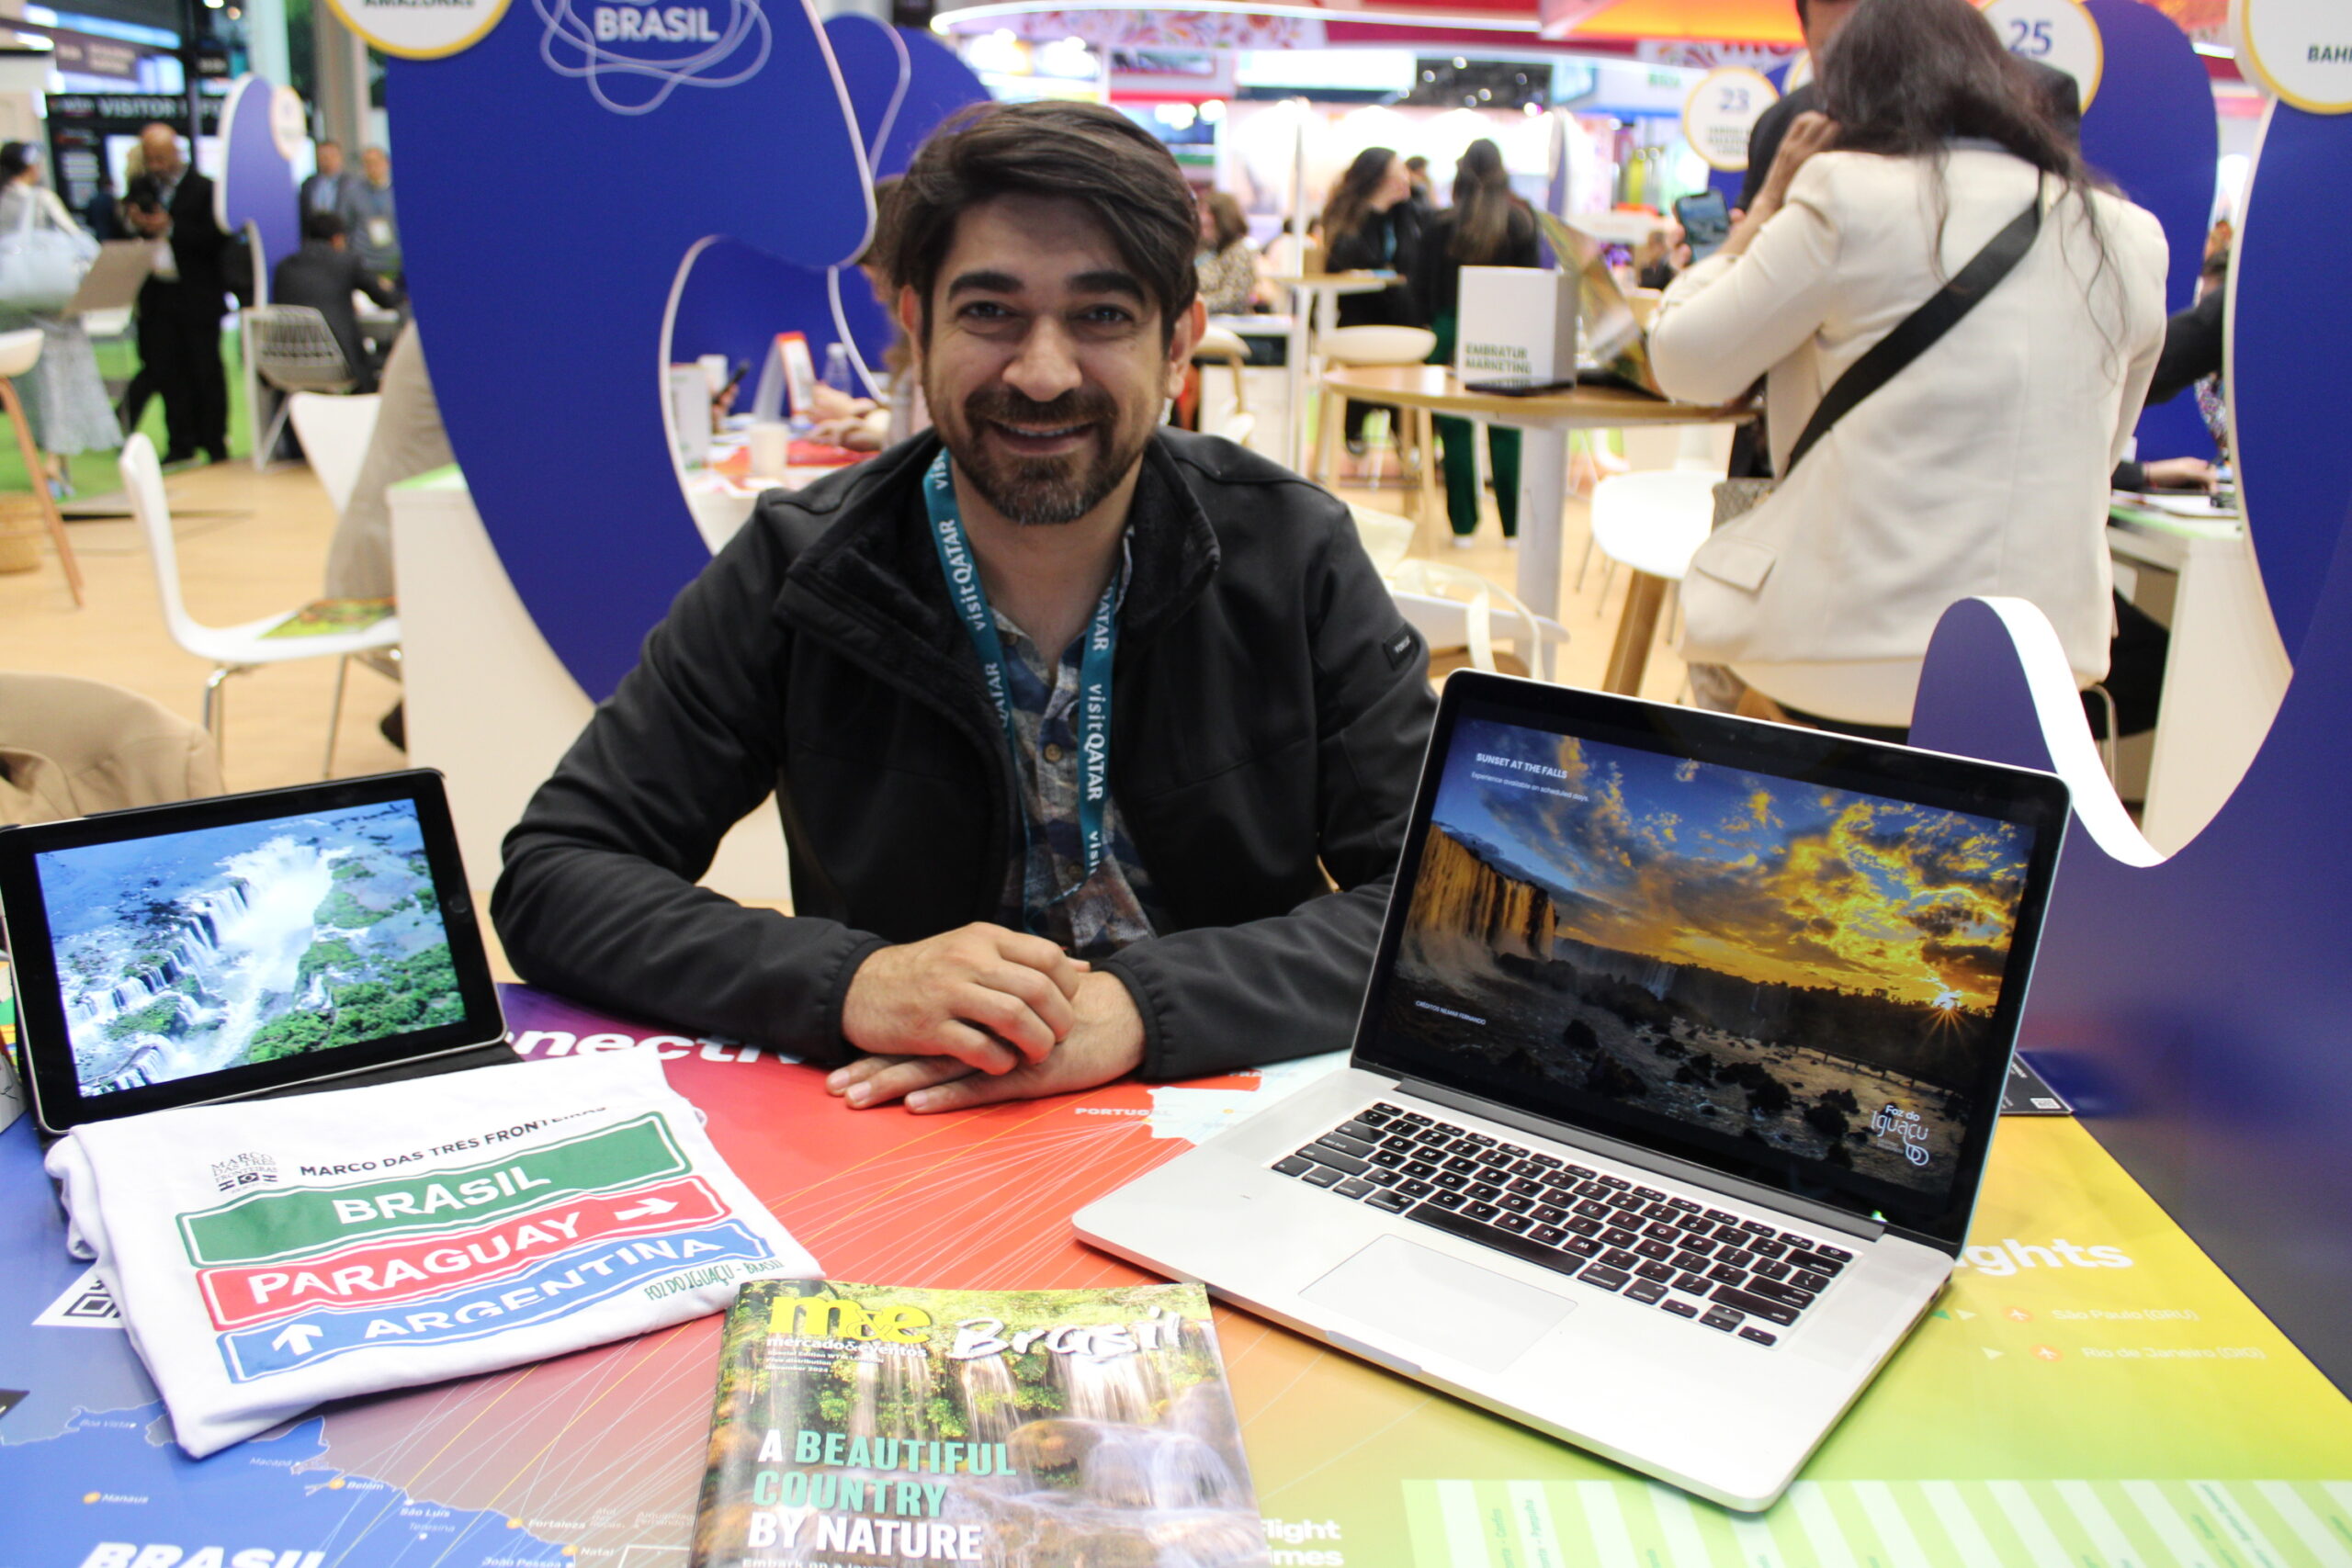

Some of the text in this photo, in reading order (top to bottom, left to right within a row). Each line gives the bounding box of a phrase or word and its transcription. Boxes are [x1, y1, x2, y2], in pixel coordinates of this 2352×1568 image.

[594, 7, 720, 41] BRASIL
[2008, 18, 2052, 55] 25
[98, 96, 177, 118] VISITOR
[1720, 88, 1749, 110] 23
[1465, 343, 1528, 359] EMBRATUR
[1465, 356, 1532, 375] MARKETING
[930, 455, 949, 490] vis
[1476, 753, 1568, 780] SUNSET AT THE FALLS
[1471, 772, 1503, 784] Experience
[1503, 776, 1532, 790] available
[1540, 786, 1573, 799] scheduled
[1871, 1110, 1929, 1141] Iguaçu
[1885, 1104, 1921, 1122] Foz do
[300, 1161, 377, 1177] MARCO
[383, 1152, 424, 1168] DAS
[332, 1166, 552, 1224] BRASIL
[251, 1213, 581, 1305] PARAGUAY
[1955, 1238, 2134, 1276] ghts
[364, 1238, 726, 1339] ARGENTINA
[644, 1282, 668, 1301] FOZ
[665, 1276, 686, 1293] DO
[684, 1265, 735, 1289] IGUAÇU
[2089, 1309, 2143, 1320] Paulo
[768, 1296, 1182, 1363] m&e Brasil
[766, 1337, 928, 1359] mercado&eventos
[2081, 1347, 2114, 1359] Rio
[2117, 1347, 2142, 1359] de
[2142, 1347, 2216, 1359] Janeiro
[757, 1428, 1017, 1477] A BEAUTIFUL
[102, 1494, 149, 1504] Manaus
[752, 1470, 948, 1518] COUNTRY
[400, 1507, 424, 1517] São
[748, 1512, 983, 1562] BY NATURE
[580, 1546, 614, 1557] Natal
